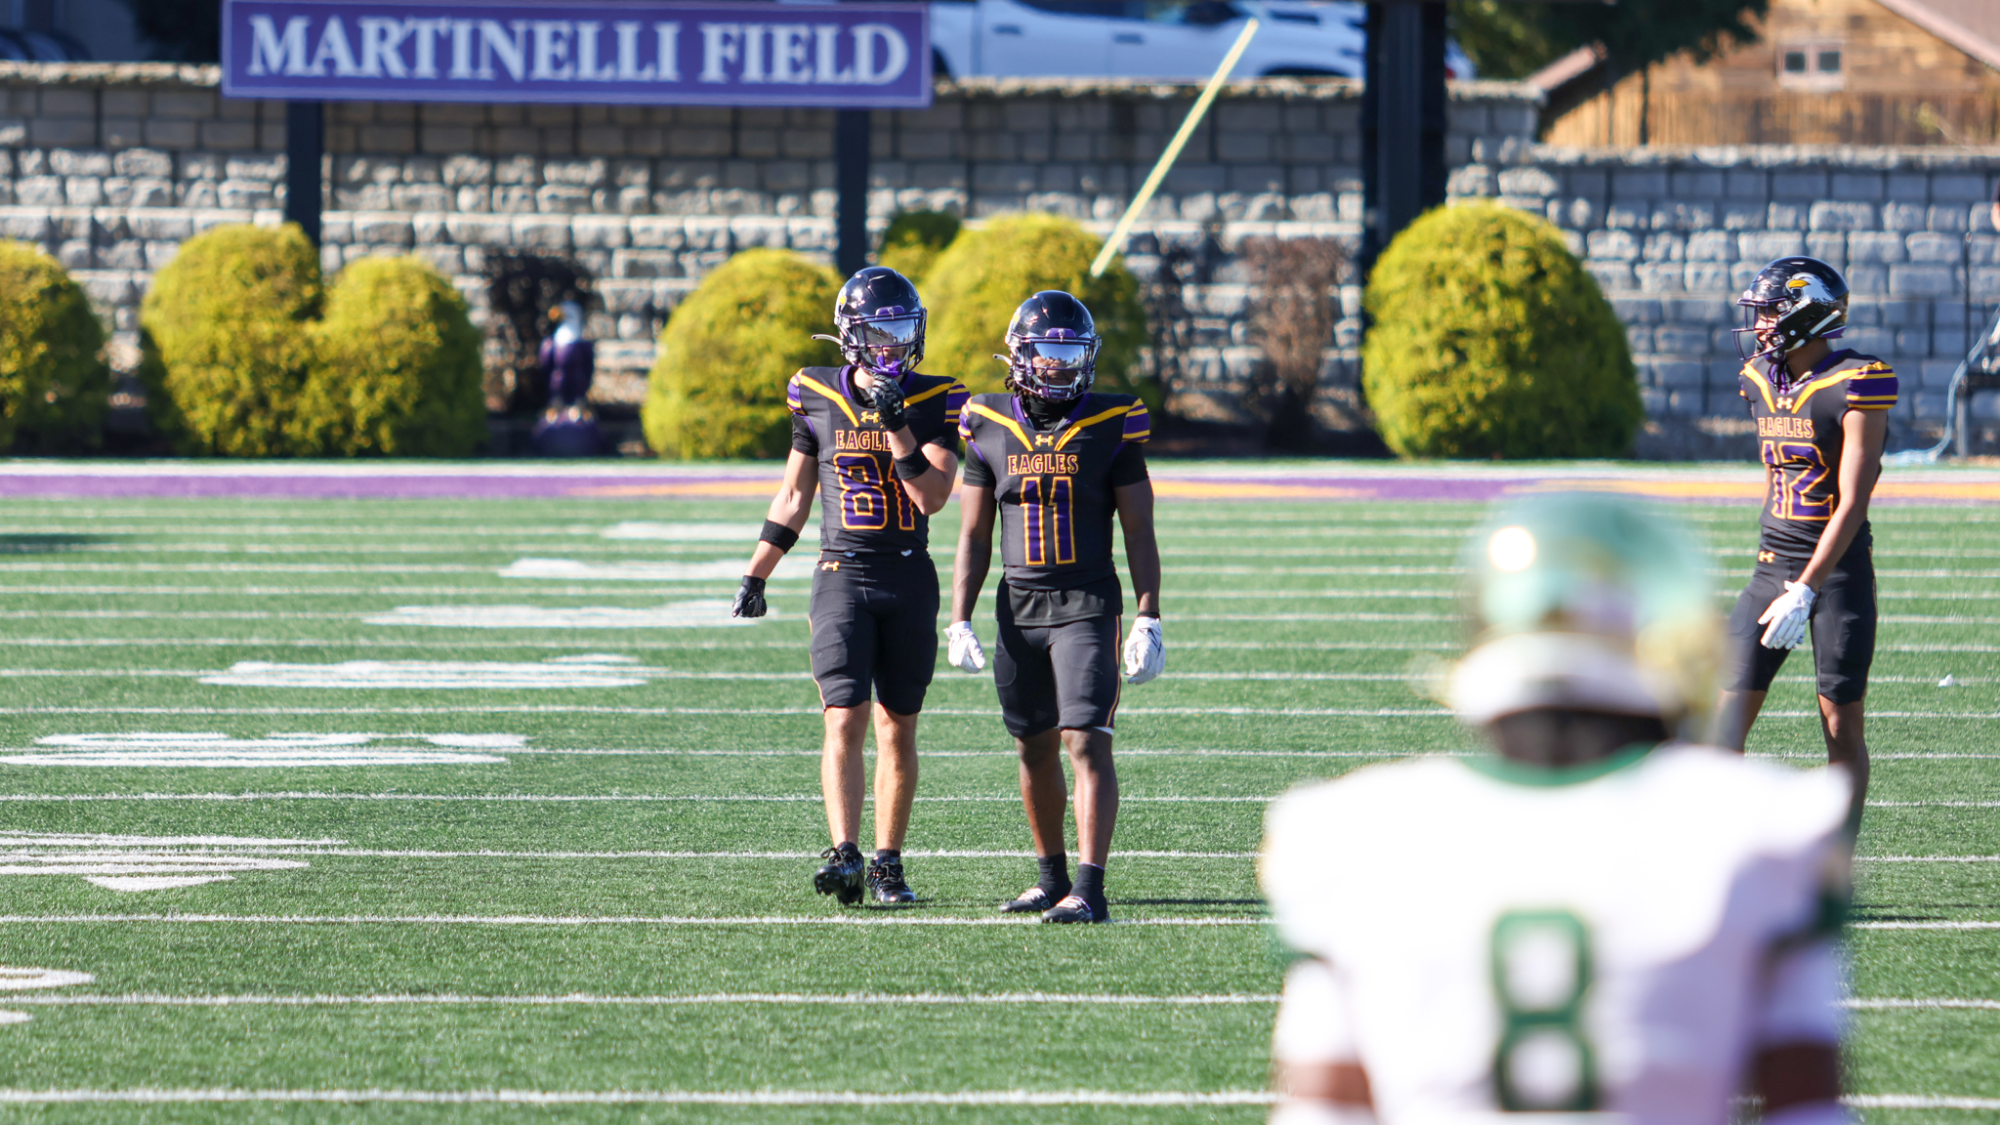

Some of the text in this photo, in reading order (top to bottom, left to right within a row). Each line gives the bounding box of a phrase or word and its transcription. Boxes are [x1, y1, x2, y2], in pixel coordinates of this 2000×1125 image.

[246, 14, 909, 85] MARTINELLI FIELD
[834, 429, 892, 451] EAGLE
[1007, 453, 1079, 475] EAGLES
[1757, 416, 1815, 439] EAGLES
[832, 451, 915, 531] 81
[1761, 439, 1834, 520] 12
[1020, 475, 1076, 566] 11
[1490, 906, 1600, 1113] 8
